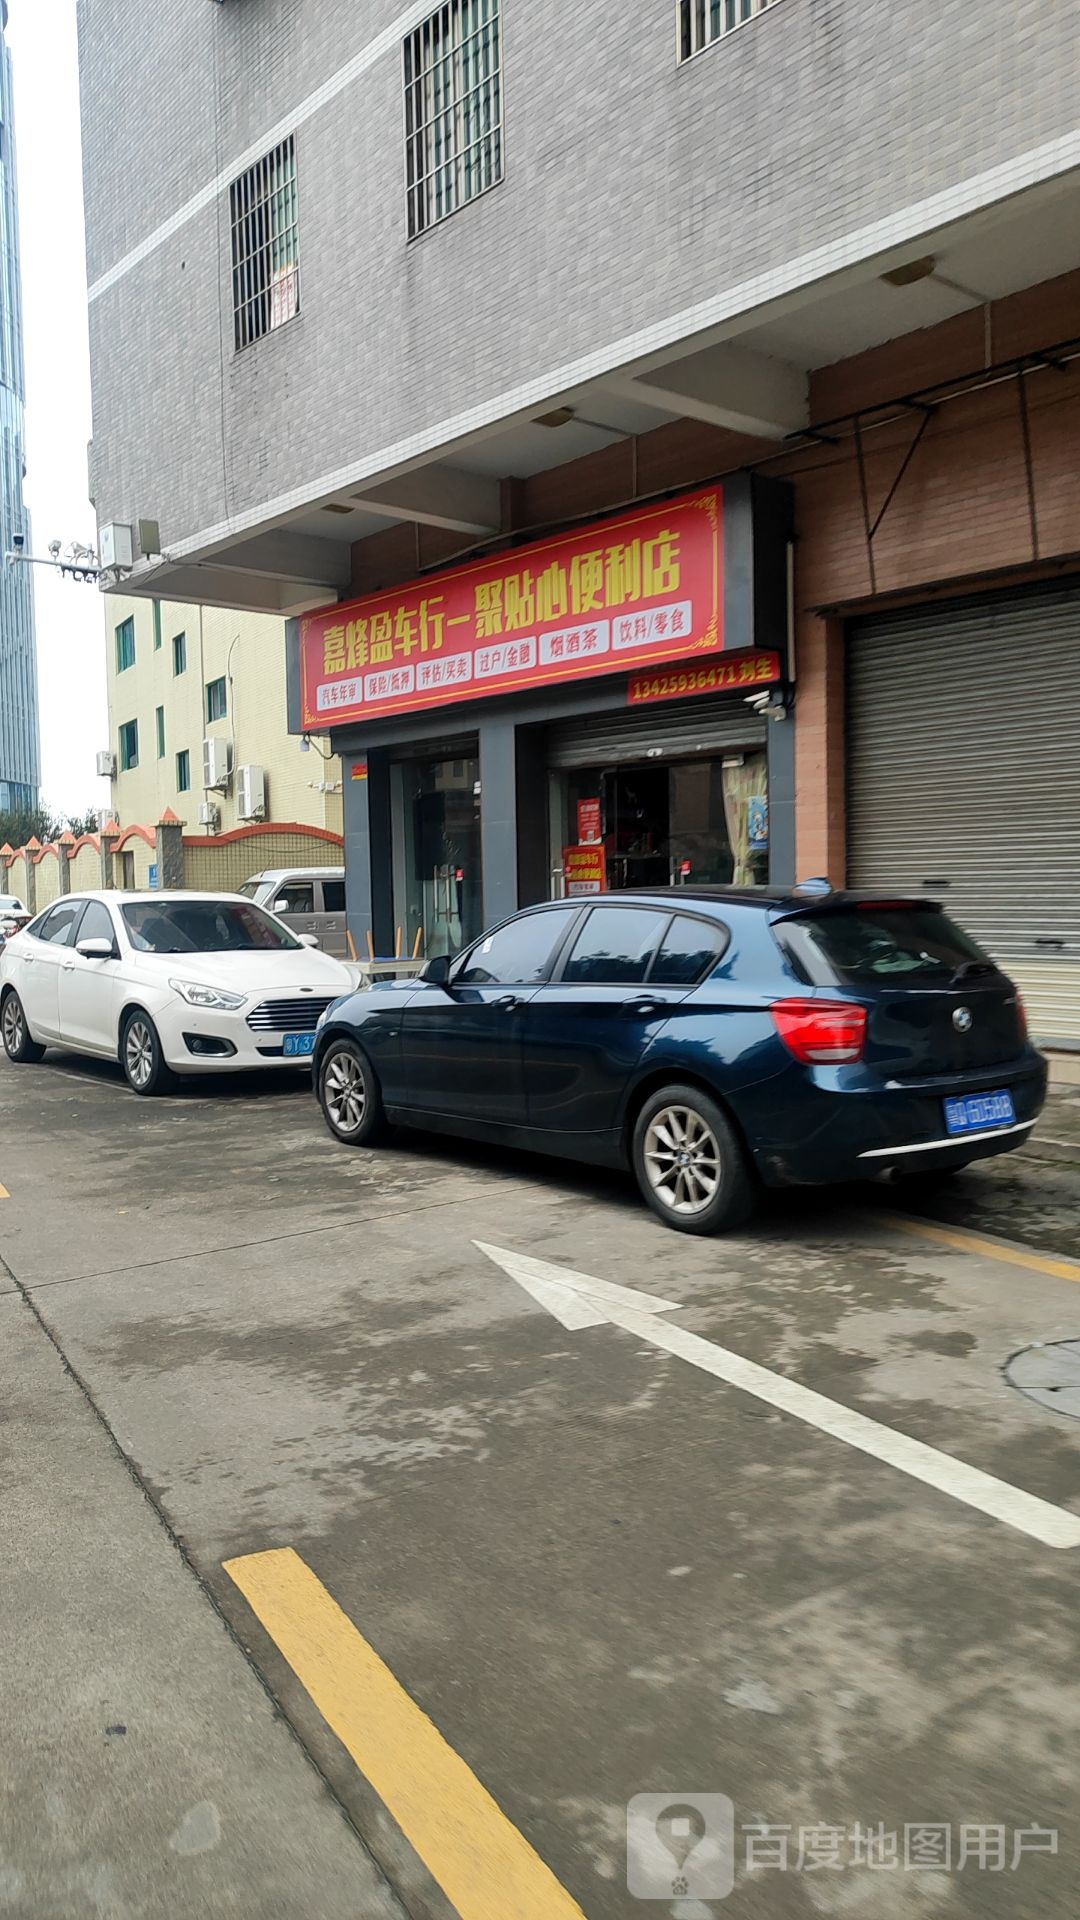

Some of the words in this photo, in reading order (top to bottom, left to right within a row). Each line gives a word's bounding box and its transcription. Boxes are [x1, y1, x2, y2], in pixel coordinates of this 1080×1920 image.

[619, 608, 685, 642] 饮料/零食
[479, 641, 532, 673] 过户/金融
[550, 627, 599, 658] 烟酒茶
[421, 657, 468, 686] 评估/买卖
[632, 665, 737, 699] 13425936471
[322, 682, 357, 705] 汽车年审
